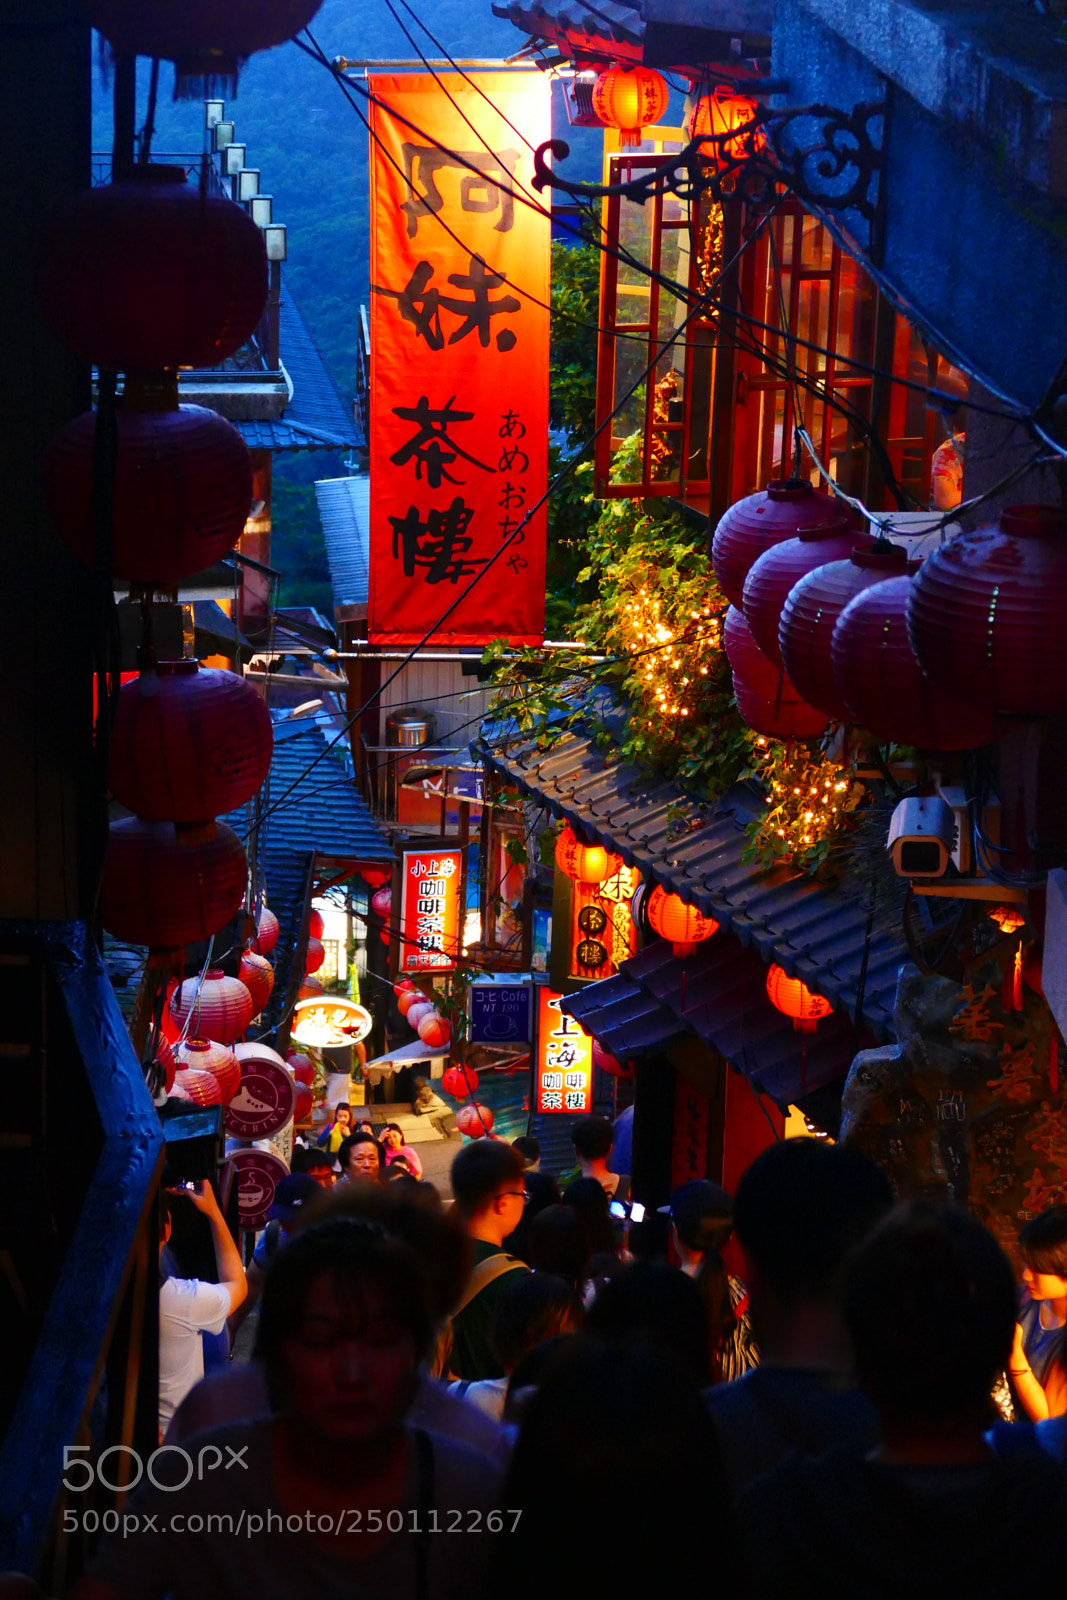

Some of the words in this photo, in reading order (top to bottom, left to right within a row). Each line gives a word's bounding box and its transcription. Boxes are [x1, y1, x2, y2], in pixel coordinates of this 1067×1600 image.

[498, 408, 530, 576] あめおちゃ
[482, 1003, 496, 1013] NT
[542, 1092, 586, 1110] 茶樓
